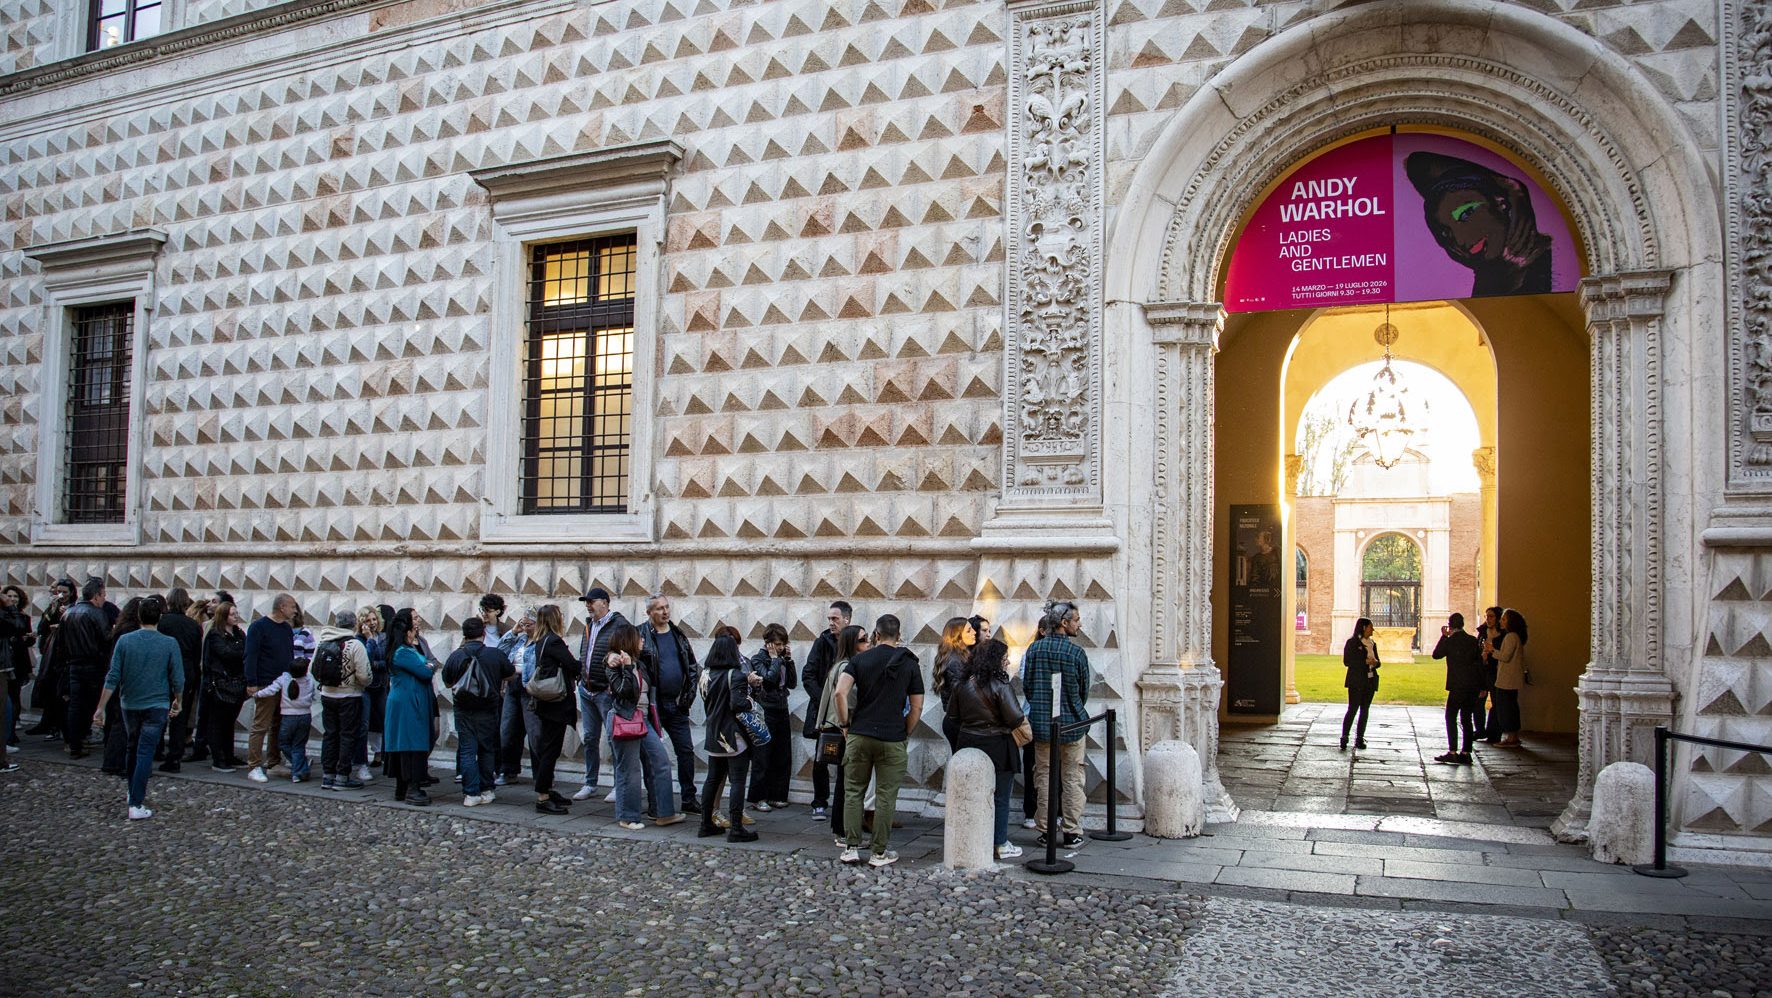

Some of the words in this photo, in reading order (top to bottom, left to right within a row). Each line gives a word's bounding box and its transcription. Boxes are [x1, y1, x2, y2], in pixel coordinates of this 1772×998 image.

[1291, 177, 1357, 200] ANDY
[1280, 197, 1385, 222] WARHOL
[1280, 229, 1331, 244] LADIES
[1279, 245, 1311, 258] AND
[1291, 253, 1386, 272] GENTLEMEN
[1301, 284, 1326, 292] MARZO
[1345, 281, 1369, 289] LUGLIO
[1315, 290, 1339, 298] GIORNI
